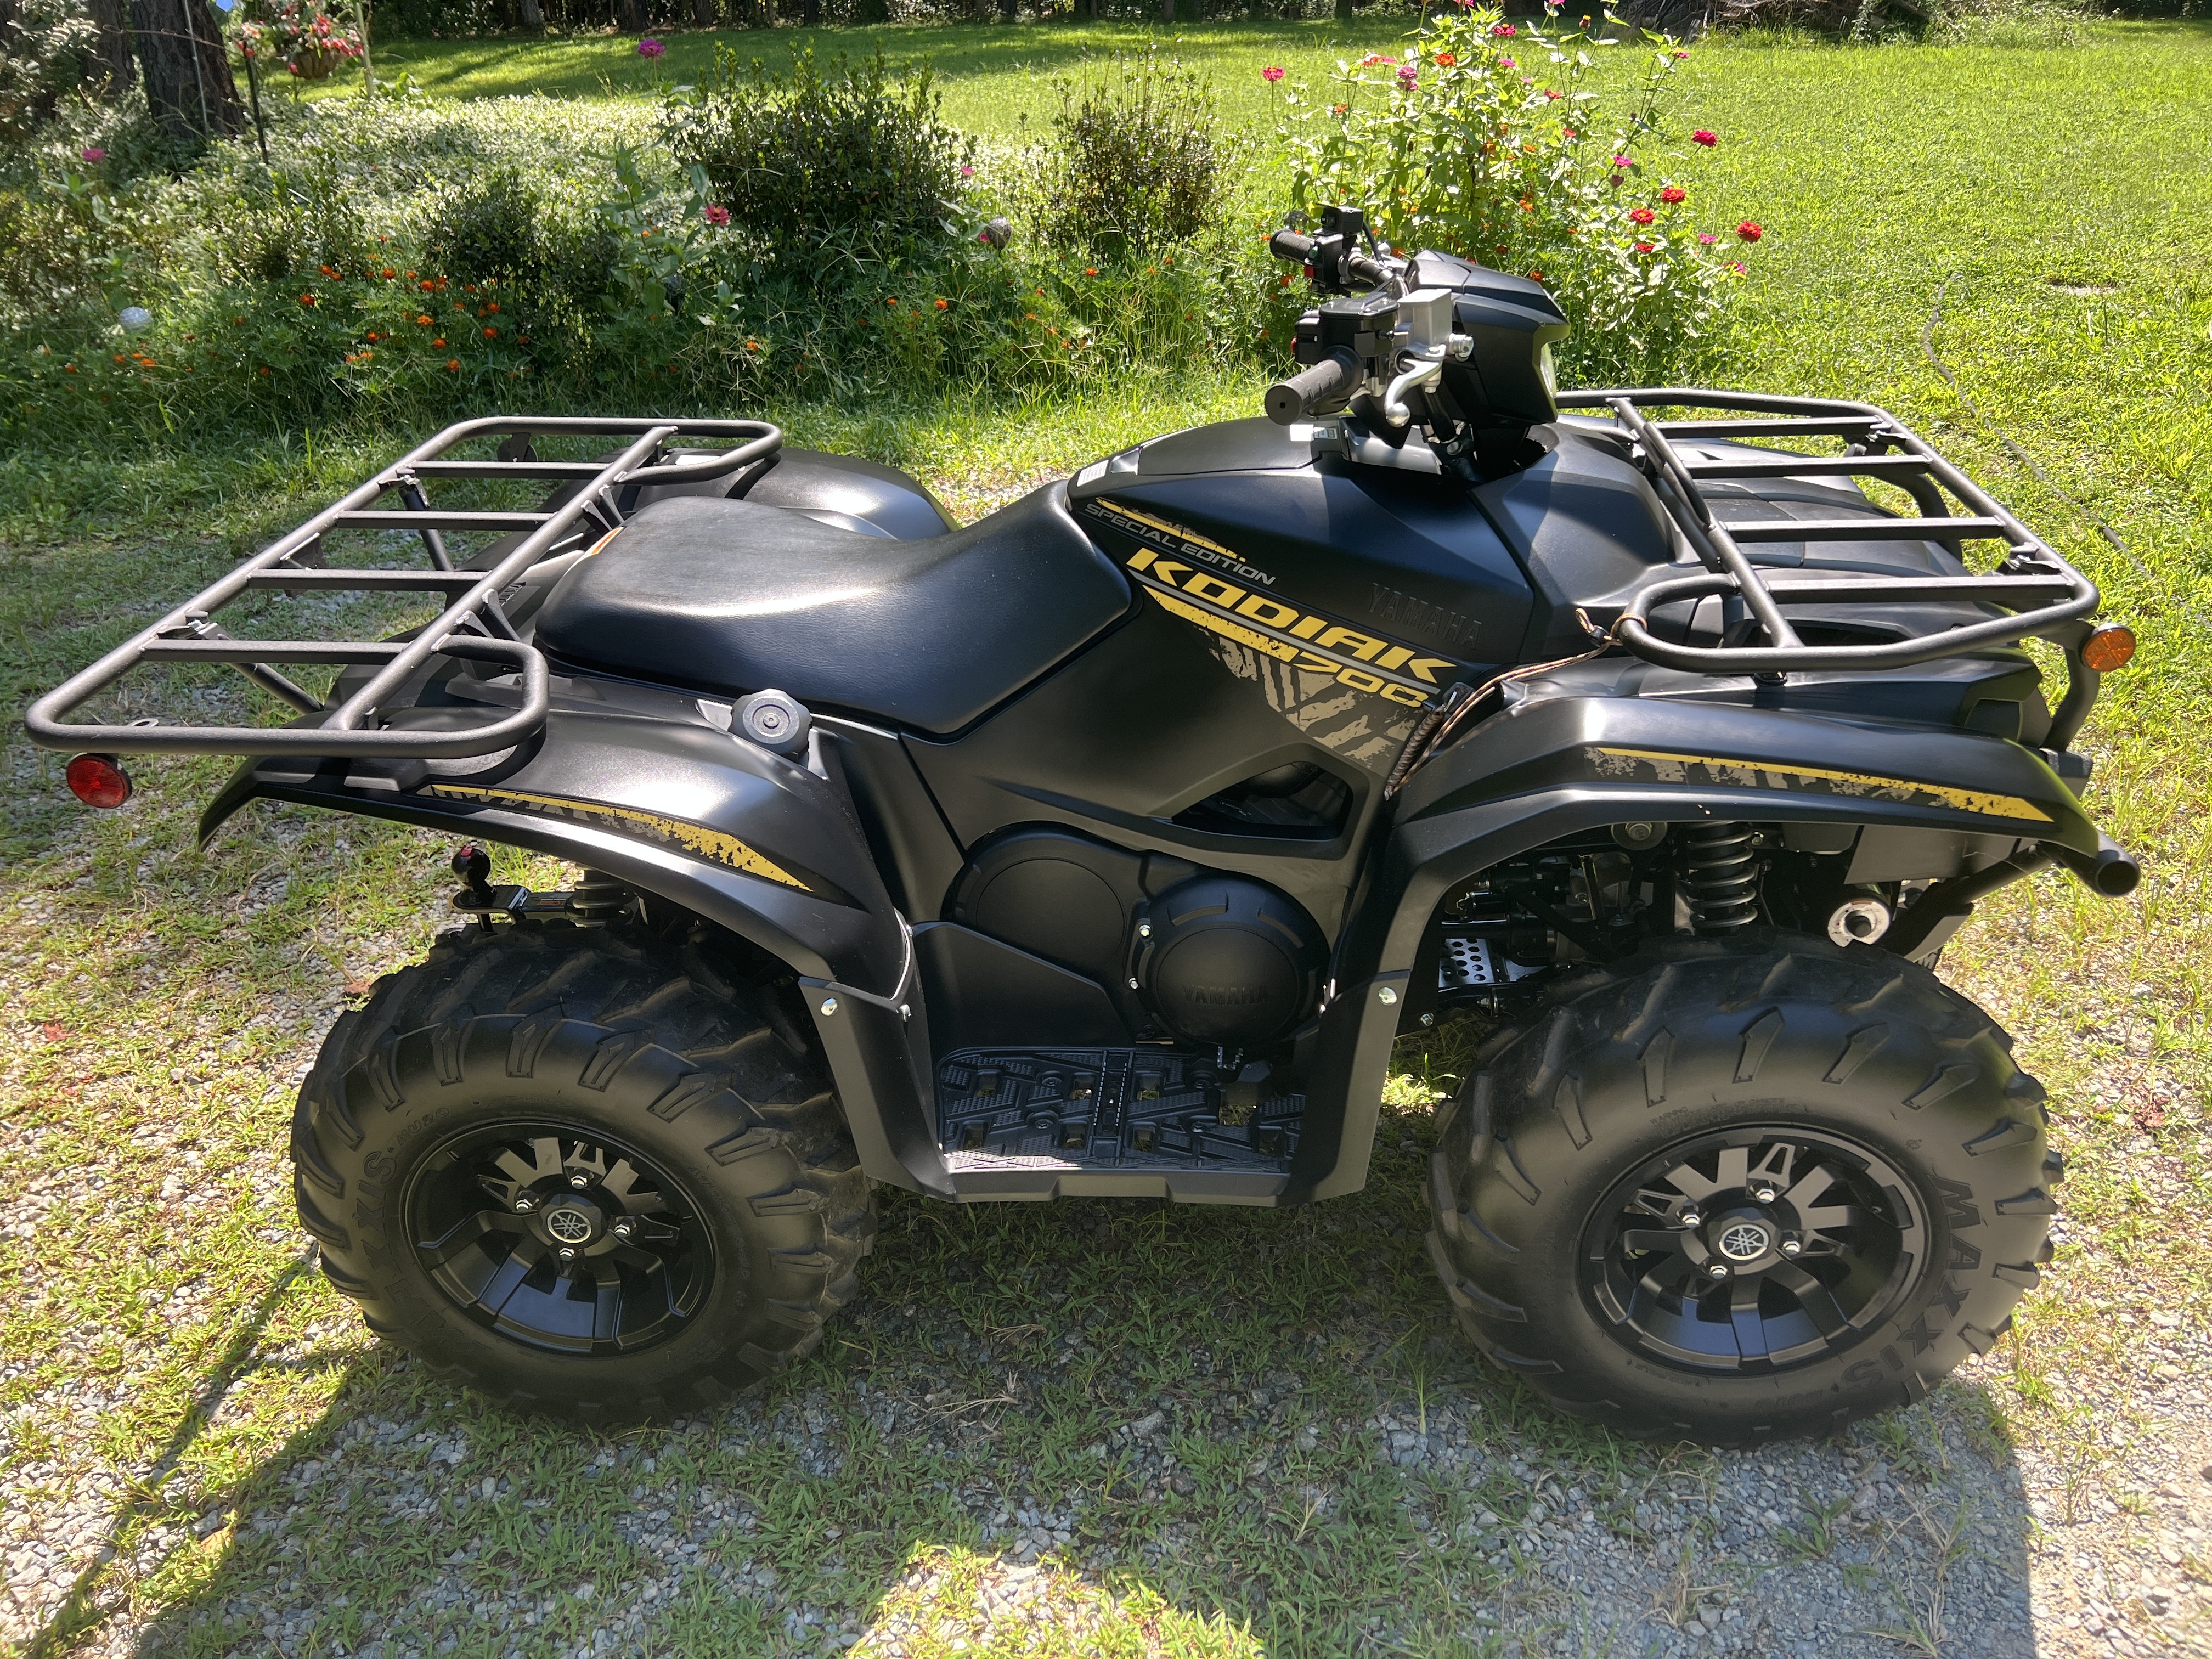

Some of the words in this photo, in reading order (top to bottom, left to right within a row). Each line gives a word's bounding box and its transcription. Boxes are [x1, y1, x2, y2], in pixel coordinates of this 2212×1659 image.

[1085, 503, 1177, 549] SPECIAL
[1180, 543, 1277, 586] EDITION
[1126, 547, 1457, 684] KODIAK
[1368, 583, 1482, 650] YAMAHA
[1293, 651, 1429, 708] 700
[1182, 984, 1268, 1005] YAMAHA
[396, 1107, 449, 1146] MU20
[1841, 1173, 1982, 1384] MAXXIS
